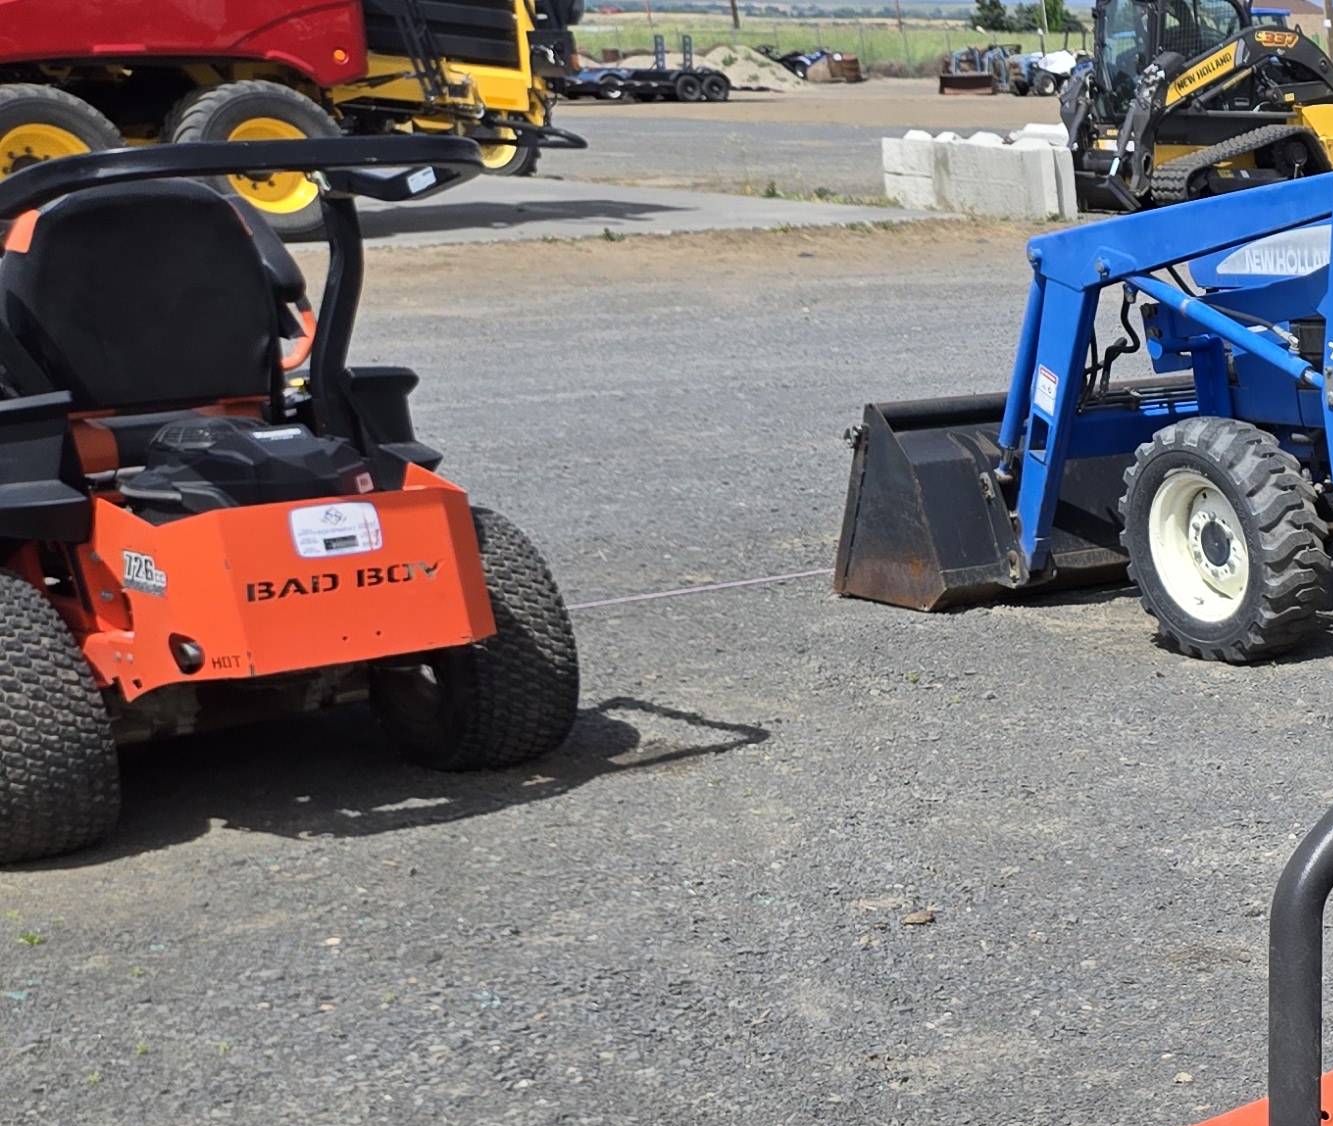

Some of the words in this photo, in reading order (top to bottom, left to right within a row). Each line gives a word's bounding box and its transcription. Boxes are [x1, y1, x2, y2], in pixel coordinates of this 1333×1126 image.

[1176, 73, 1196, 91] NEW
[1197, 52, 1232, 80] HOLLAND
[1245, 249, 1274, 273] NEW
[246, 572, 339, 602] BAD
[356, 560, 443, 588] BOY
[211, 655, 241, 669] HOT
